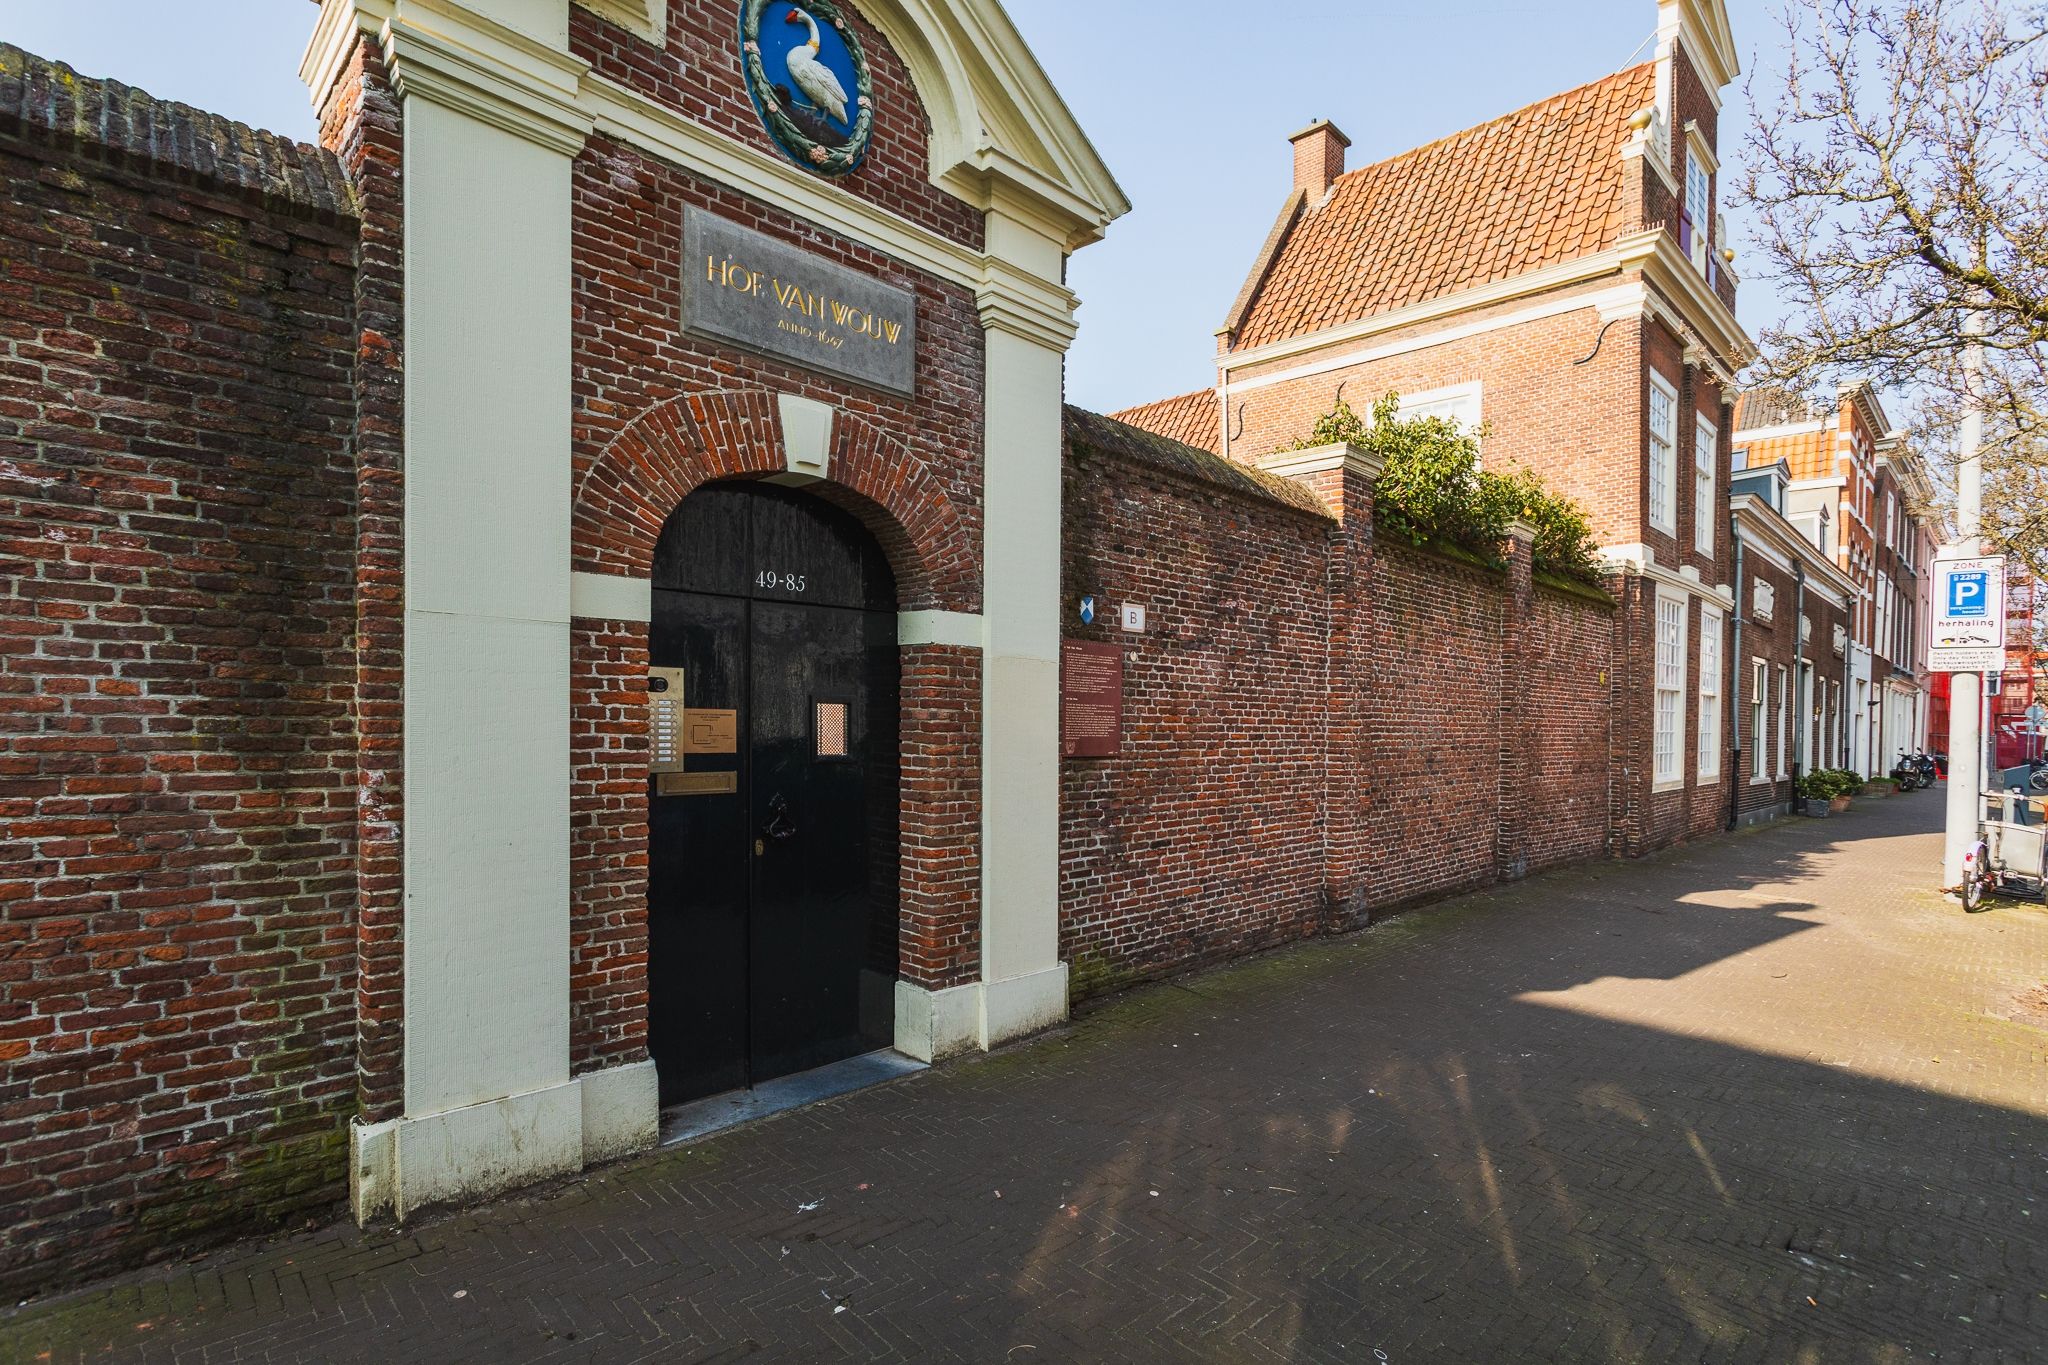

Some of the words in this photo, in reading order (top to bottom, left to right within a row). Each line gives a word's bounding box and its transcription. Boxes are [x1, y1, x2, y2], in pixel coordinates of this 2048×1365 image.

[707, 255, 764, 297] HOF
[772, 278, 824, 321] VAN
[830, 300, 902, 345] WOUW
[777, 319, 812, 338] ANNO
[1952, 561, 1983, 570] ZONE
[755, 570, 805, 592] 49-85
[1960, 573, 1982, 581] 2289
[1955, 582, 1980, 606] P
[1130, 611, 1137, 624] B
[1938, 619, 1994, 627] herhaling
